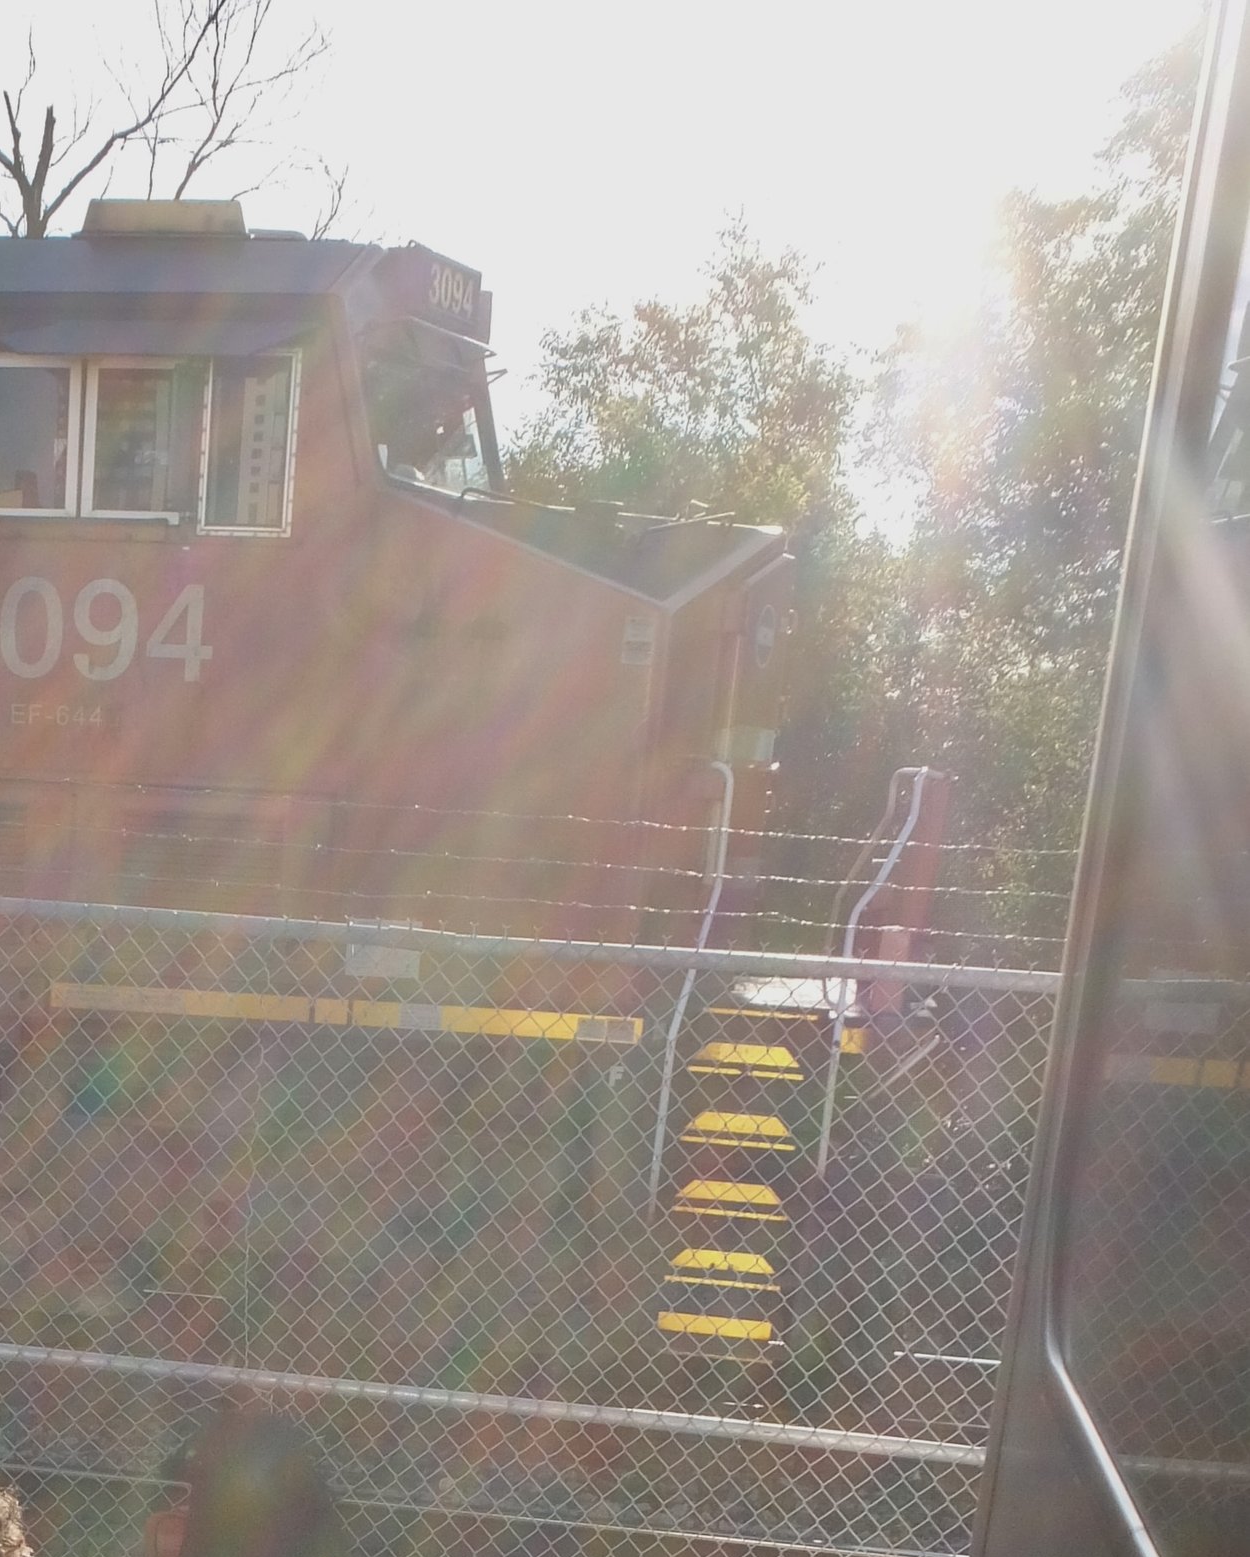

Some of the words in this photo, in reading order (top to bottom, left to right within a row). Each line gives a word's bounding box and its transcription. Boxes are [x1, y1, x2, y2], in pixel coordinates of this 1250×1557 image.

[429, 263, 473, 318] 3094
[10, 703, 103, 728] EF-644
[609, 1065, 624, 1087] F
